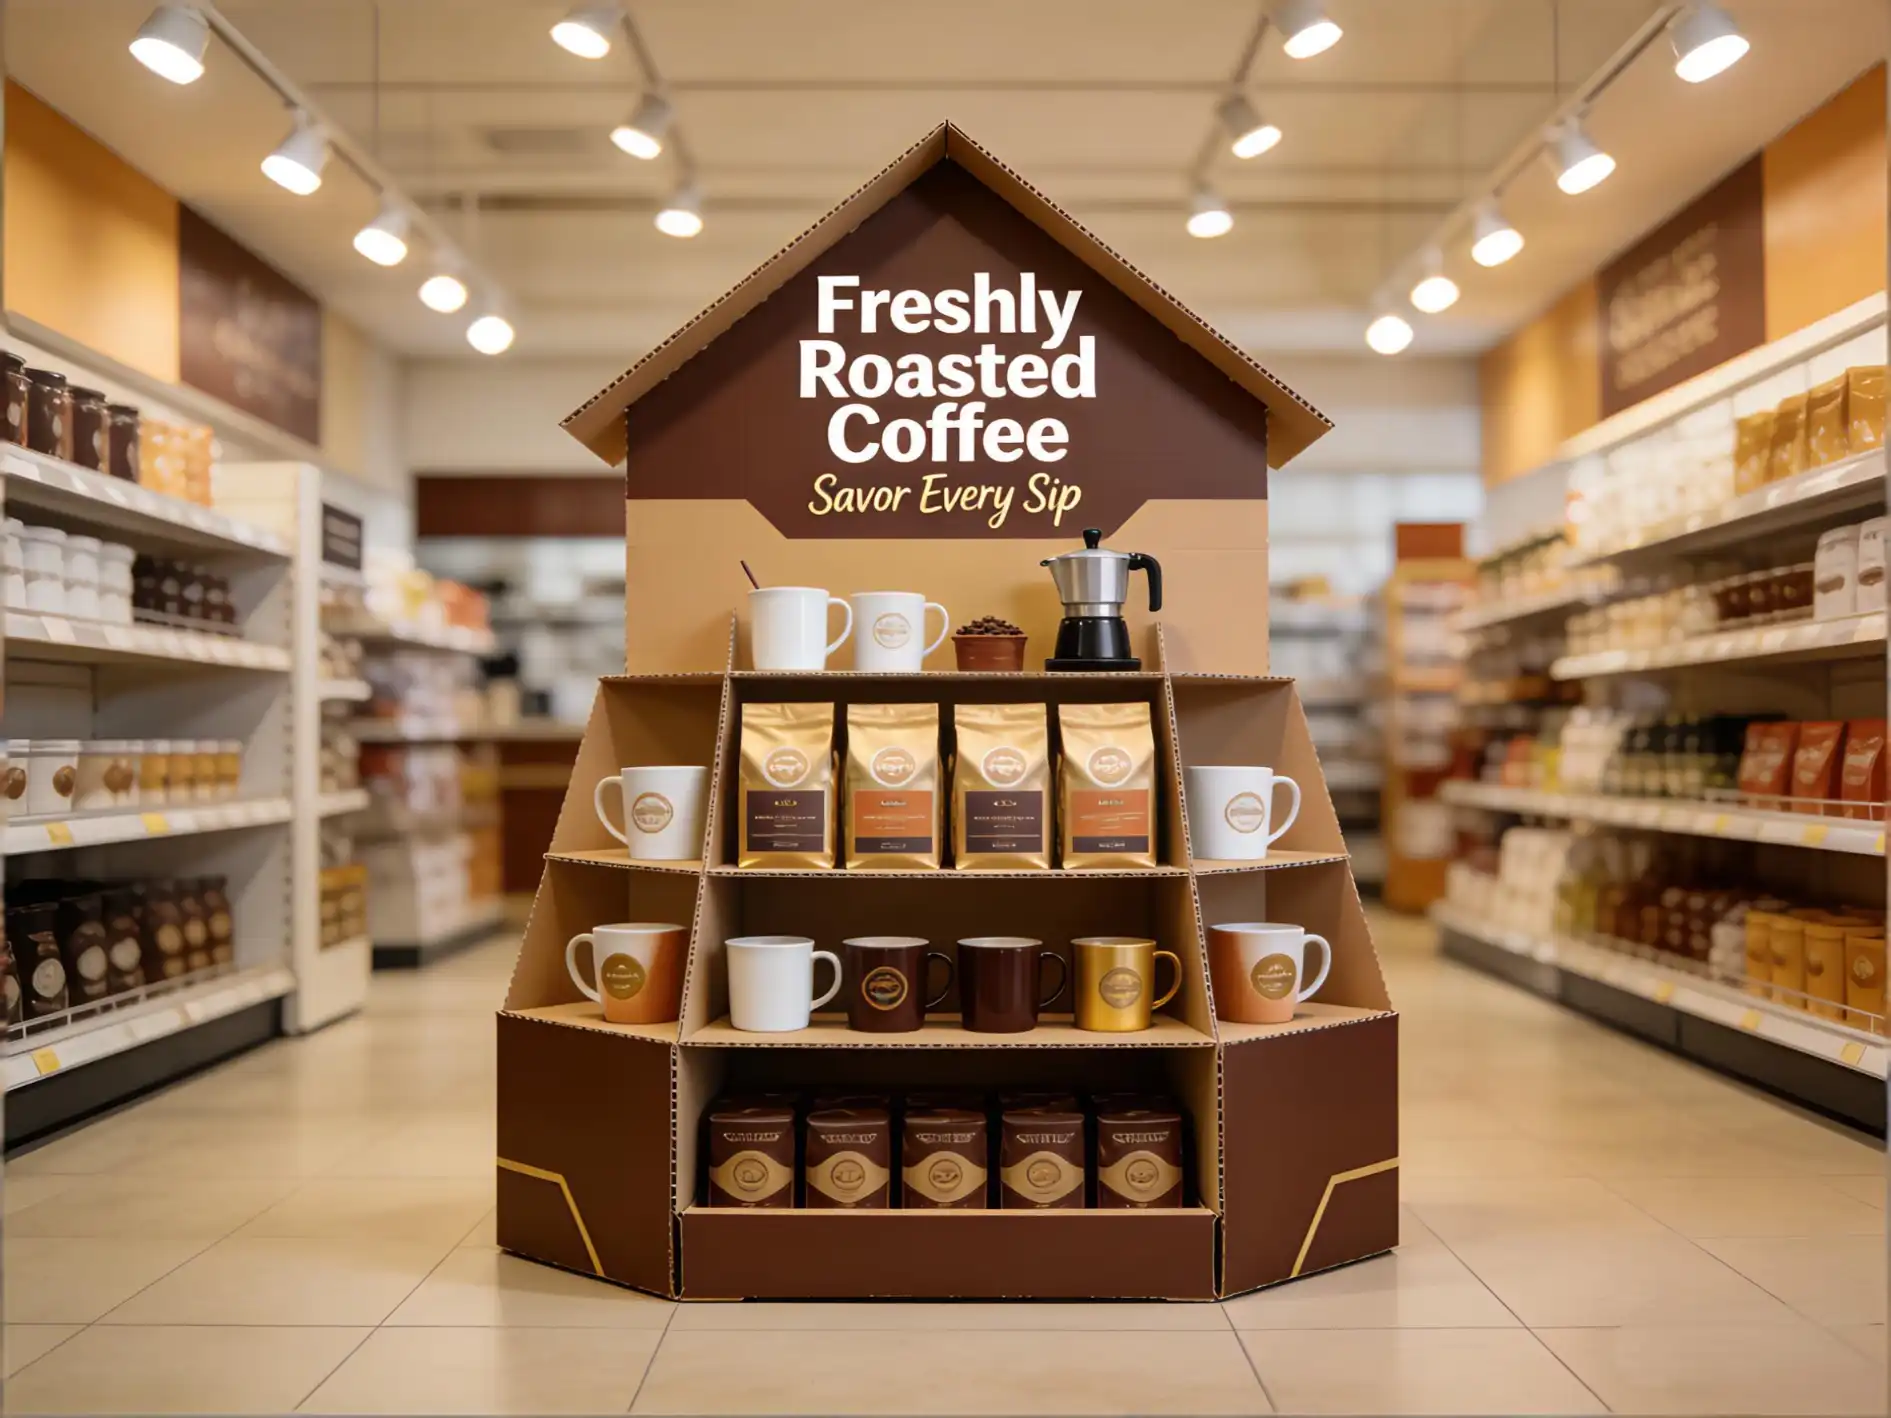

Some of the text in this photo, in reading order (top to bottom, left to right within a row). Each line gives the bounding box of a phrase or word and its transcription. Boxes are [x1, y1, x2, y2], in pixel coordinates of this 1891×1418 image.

[817, 272, 1082, 349] Freshly
[799, 336, 1096, 398] Roasted
[827, 401, 1069, 463] Coffee
[808, 472, 1082, 529] Savor Every Sip
